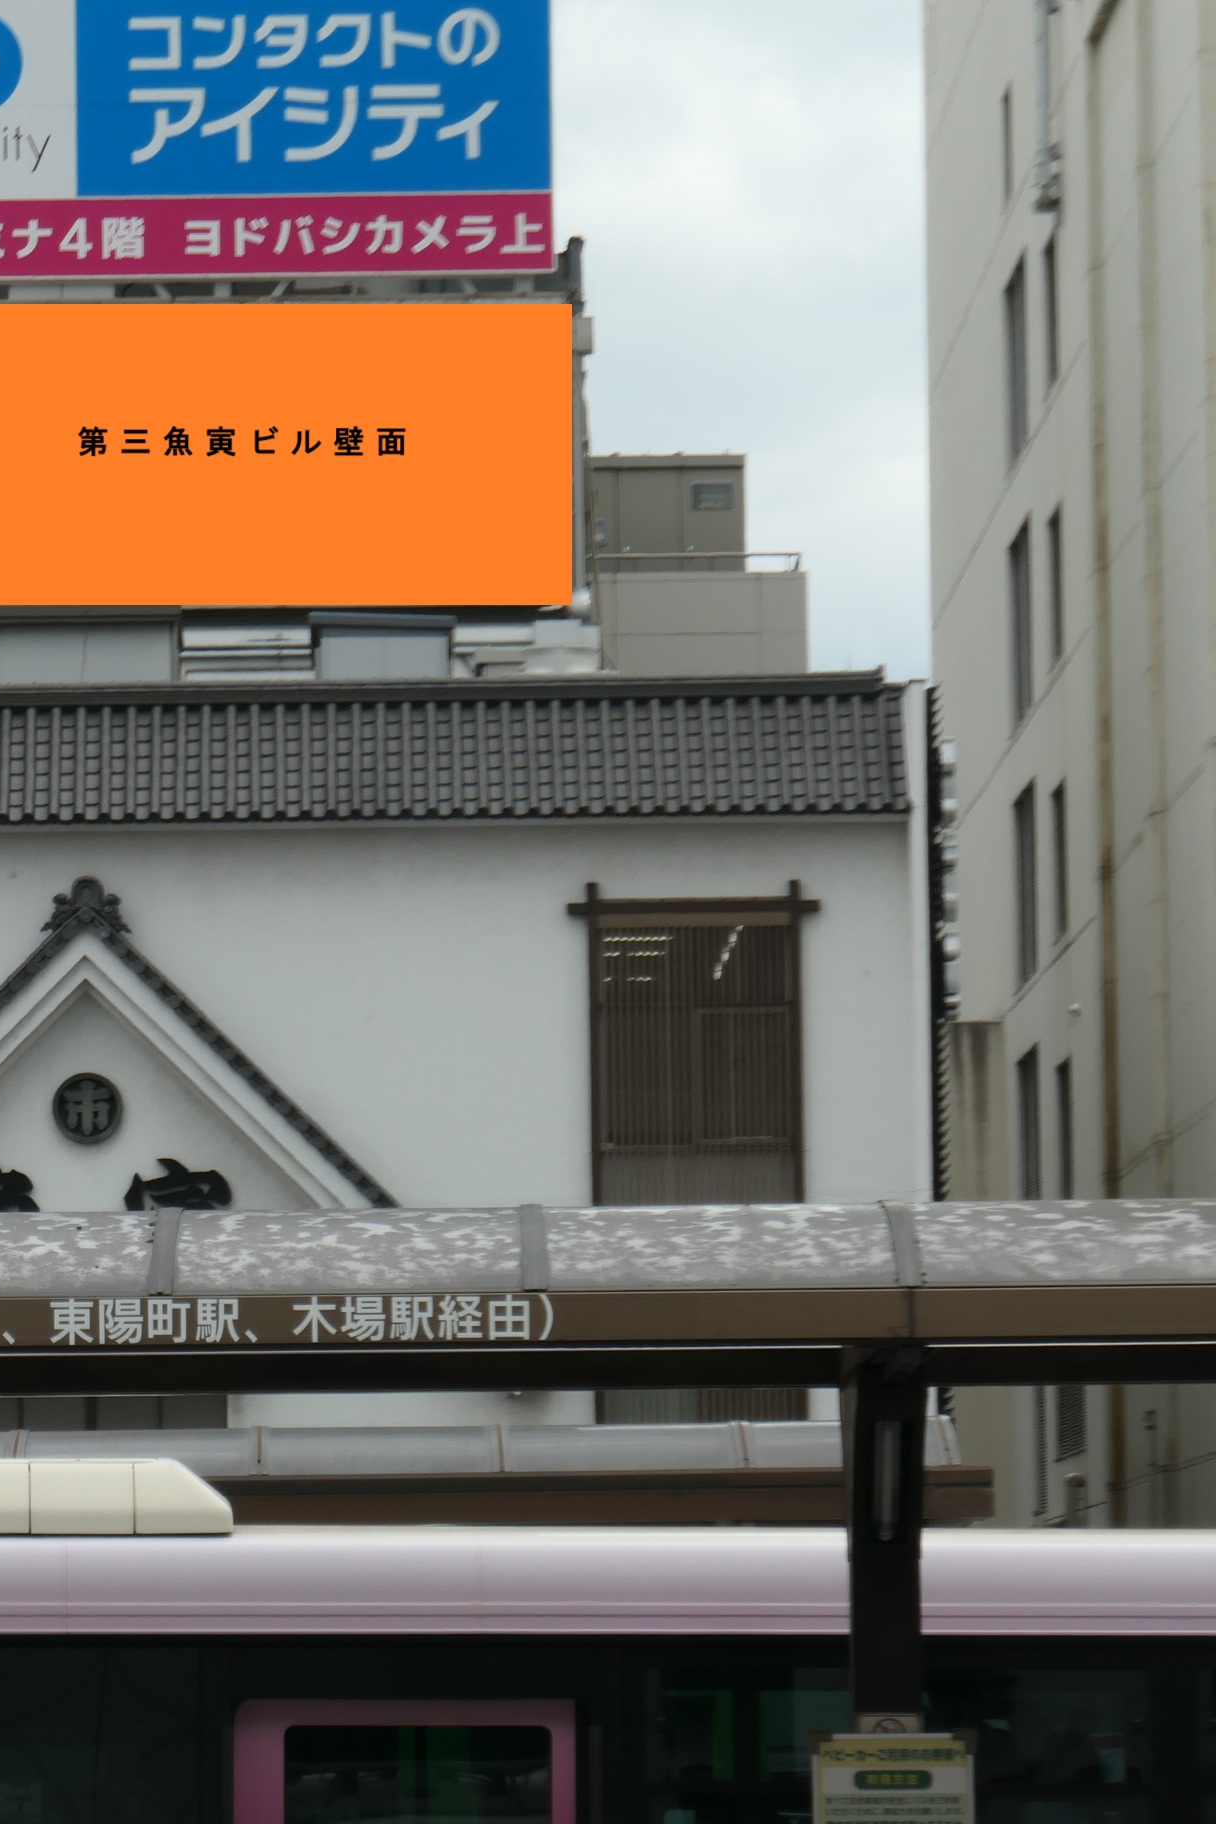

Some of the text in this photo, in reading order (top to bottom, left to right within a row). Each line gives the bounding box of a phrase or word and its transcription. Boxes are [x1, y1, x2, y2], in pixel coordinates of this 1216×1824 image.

[127, 8, 501, 69] コンタクトの
[128, 84, 500, 164] アイシティ
[184, 212, 547, 258] ヨドバシカメラ上
